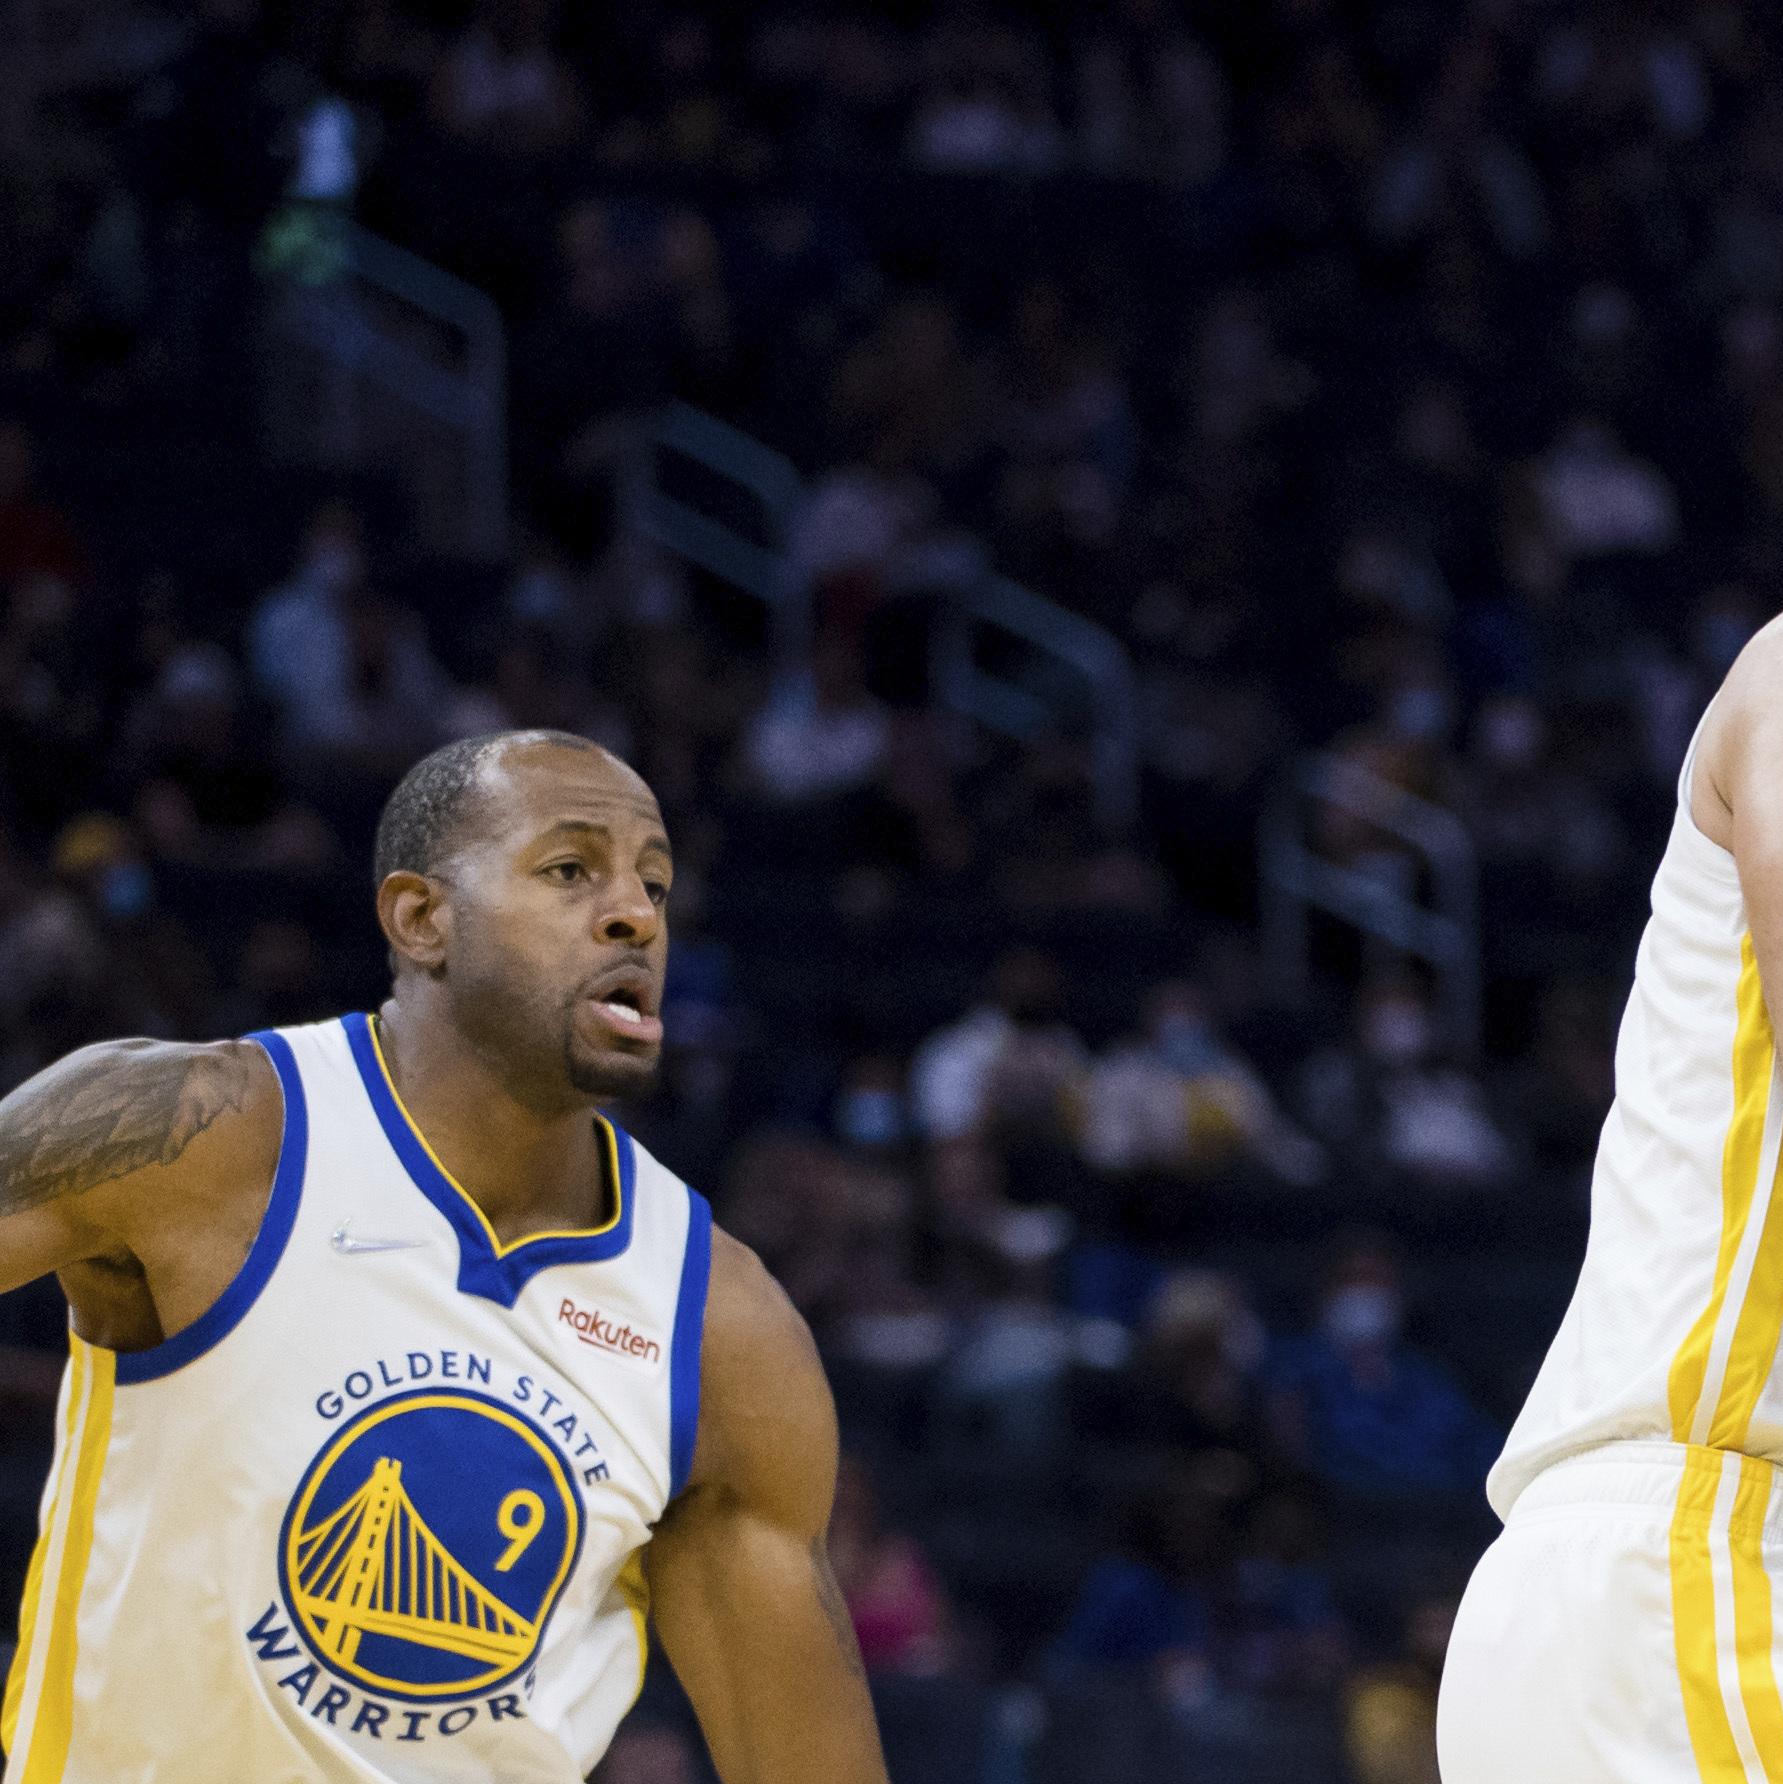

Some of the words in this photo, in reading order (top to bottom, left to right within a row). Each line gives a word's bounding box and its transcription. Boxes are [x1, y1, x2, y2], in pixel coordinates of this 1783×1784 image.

[557, 1297, 662, 1364] Rakuten
[315, 1349, 493, 1420] GOLDEN
[512, 1375, 611, 1486] STATE
[494, 1488, 546, 1573] 9
